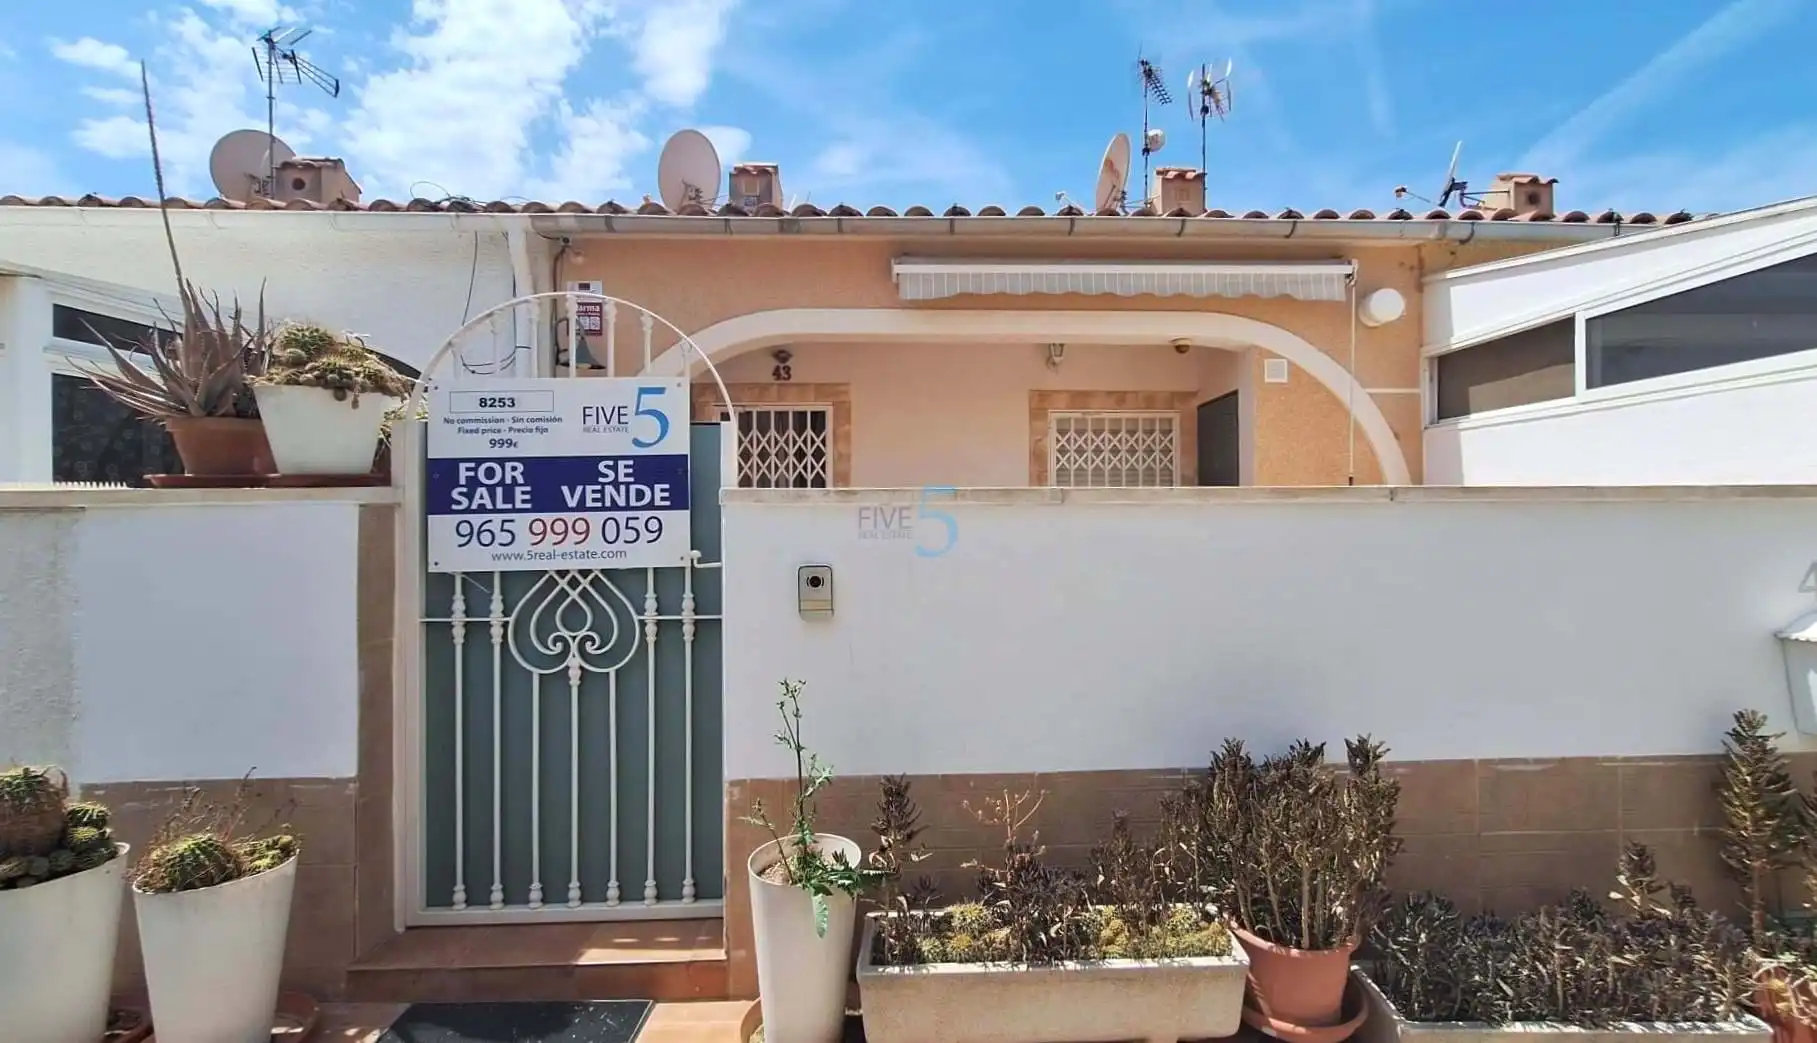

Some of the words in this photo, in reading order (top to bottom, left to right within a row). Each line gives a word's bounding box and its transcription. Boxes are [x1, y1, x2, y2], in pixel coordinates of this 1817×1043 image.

[772, 365, 791, 381] 43
[479, 397, 516, 408] 8253
[456, 416, 505, 424] commission
[526, 415, 563, 423] comisión
[583, 406, 628, 425] FIVE
[632, 387, 669, 448] 5
[481, 427, 502, 436] price
[535, 426, 549, 435] fijo
[489, 438, 518, 449] 999€
[458, 462, 525, 485] FOR
[598, 460, 634, 482] SE
[451, 486, 532, 510] SALE
[561, 484, 671, 508] VENDE
[455, 519, 516, 548] 965
[528, 517, 591, 546] 999
[601, 516, 663, 545] 059
[491, 548, 627, 561] www.5real-estate.com
